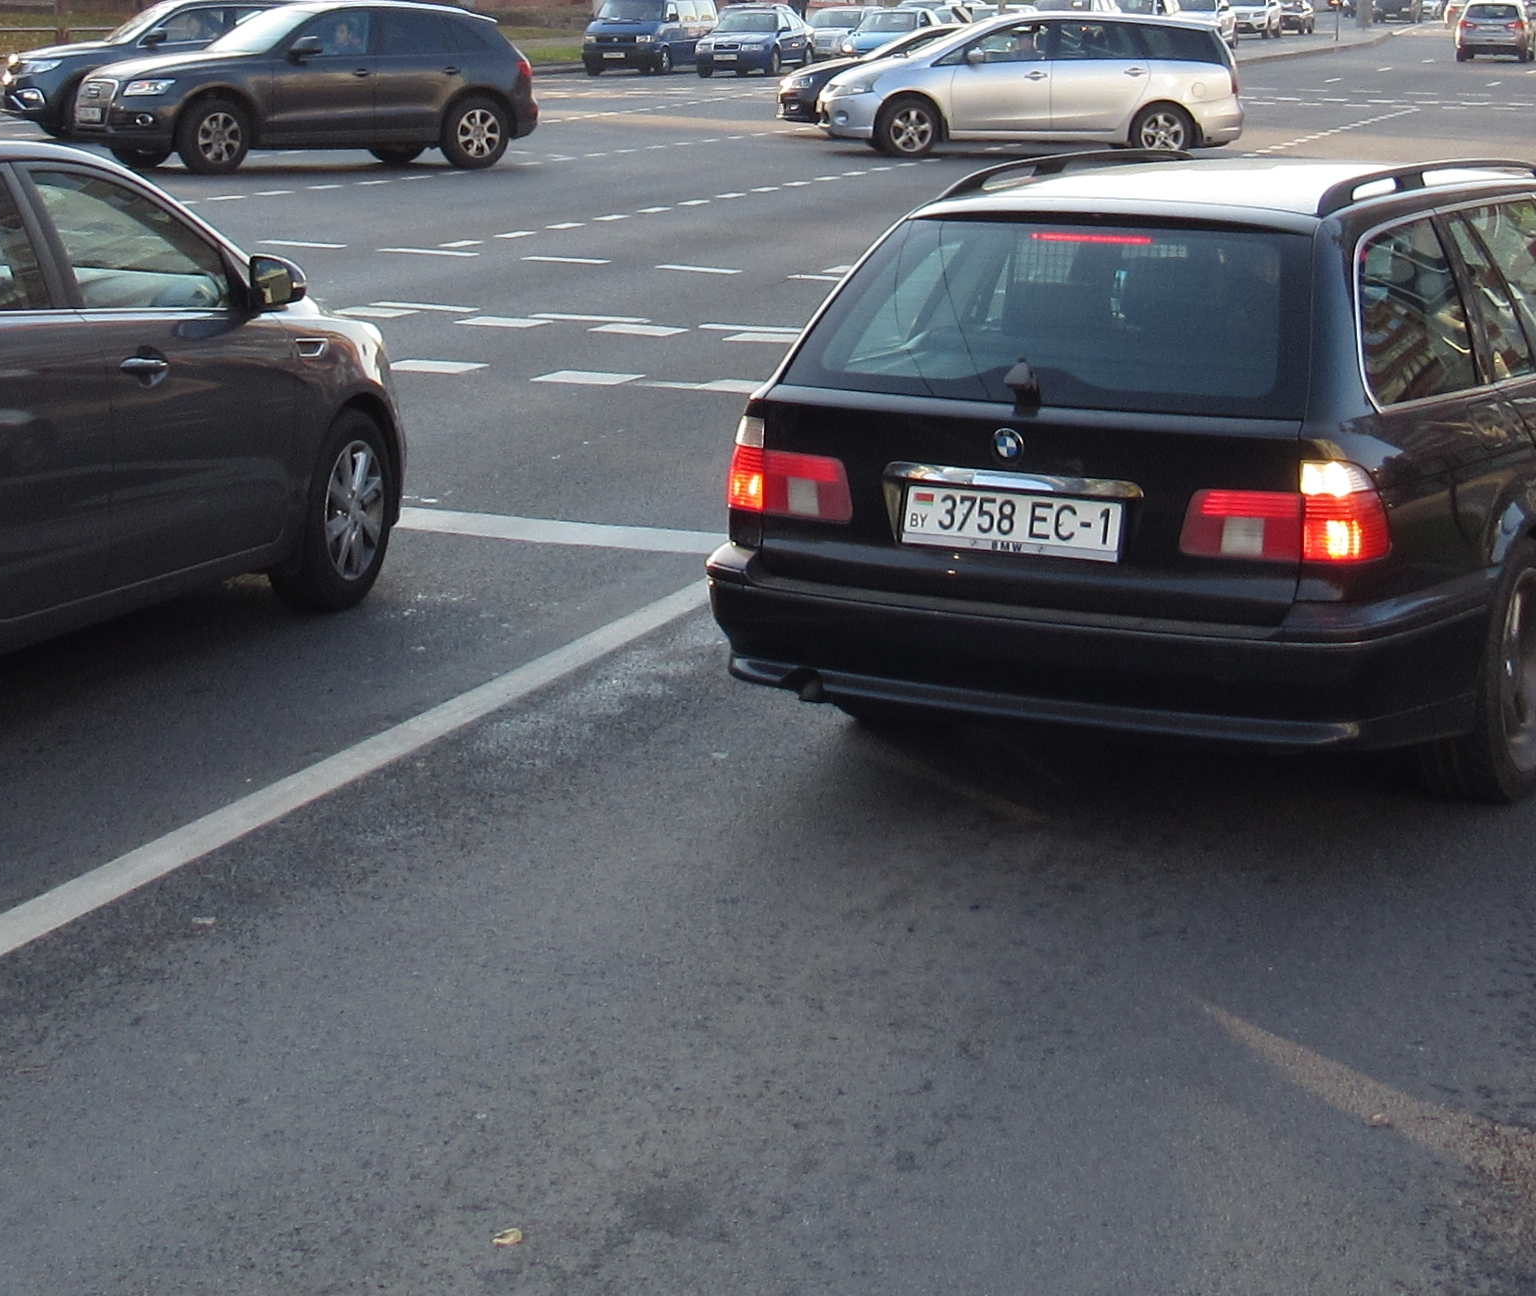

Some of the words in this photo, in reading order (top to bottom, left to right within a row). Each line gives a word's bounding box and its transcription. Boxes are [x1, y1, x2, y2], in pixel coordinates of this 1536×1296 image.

[910, 512, 929, 528] BY
[937, 495, 1017, 536] 3758
[1028, 501, 1111, 545] EC-1
[990, 539, 1023, 553] BMW
